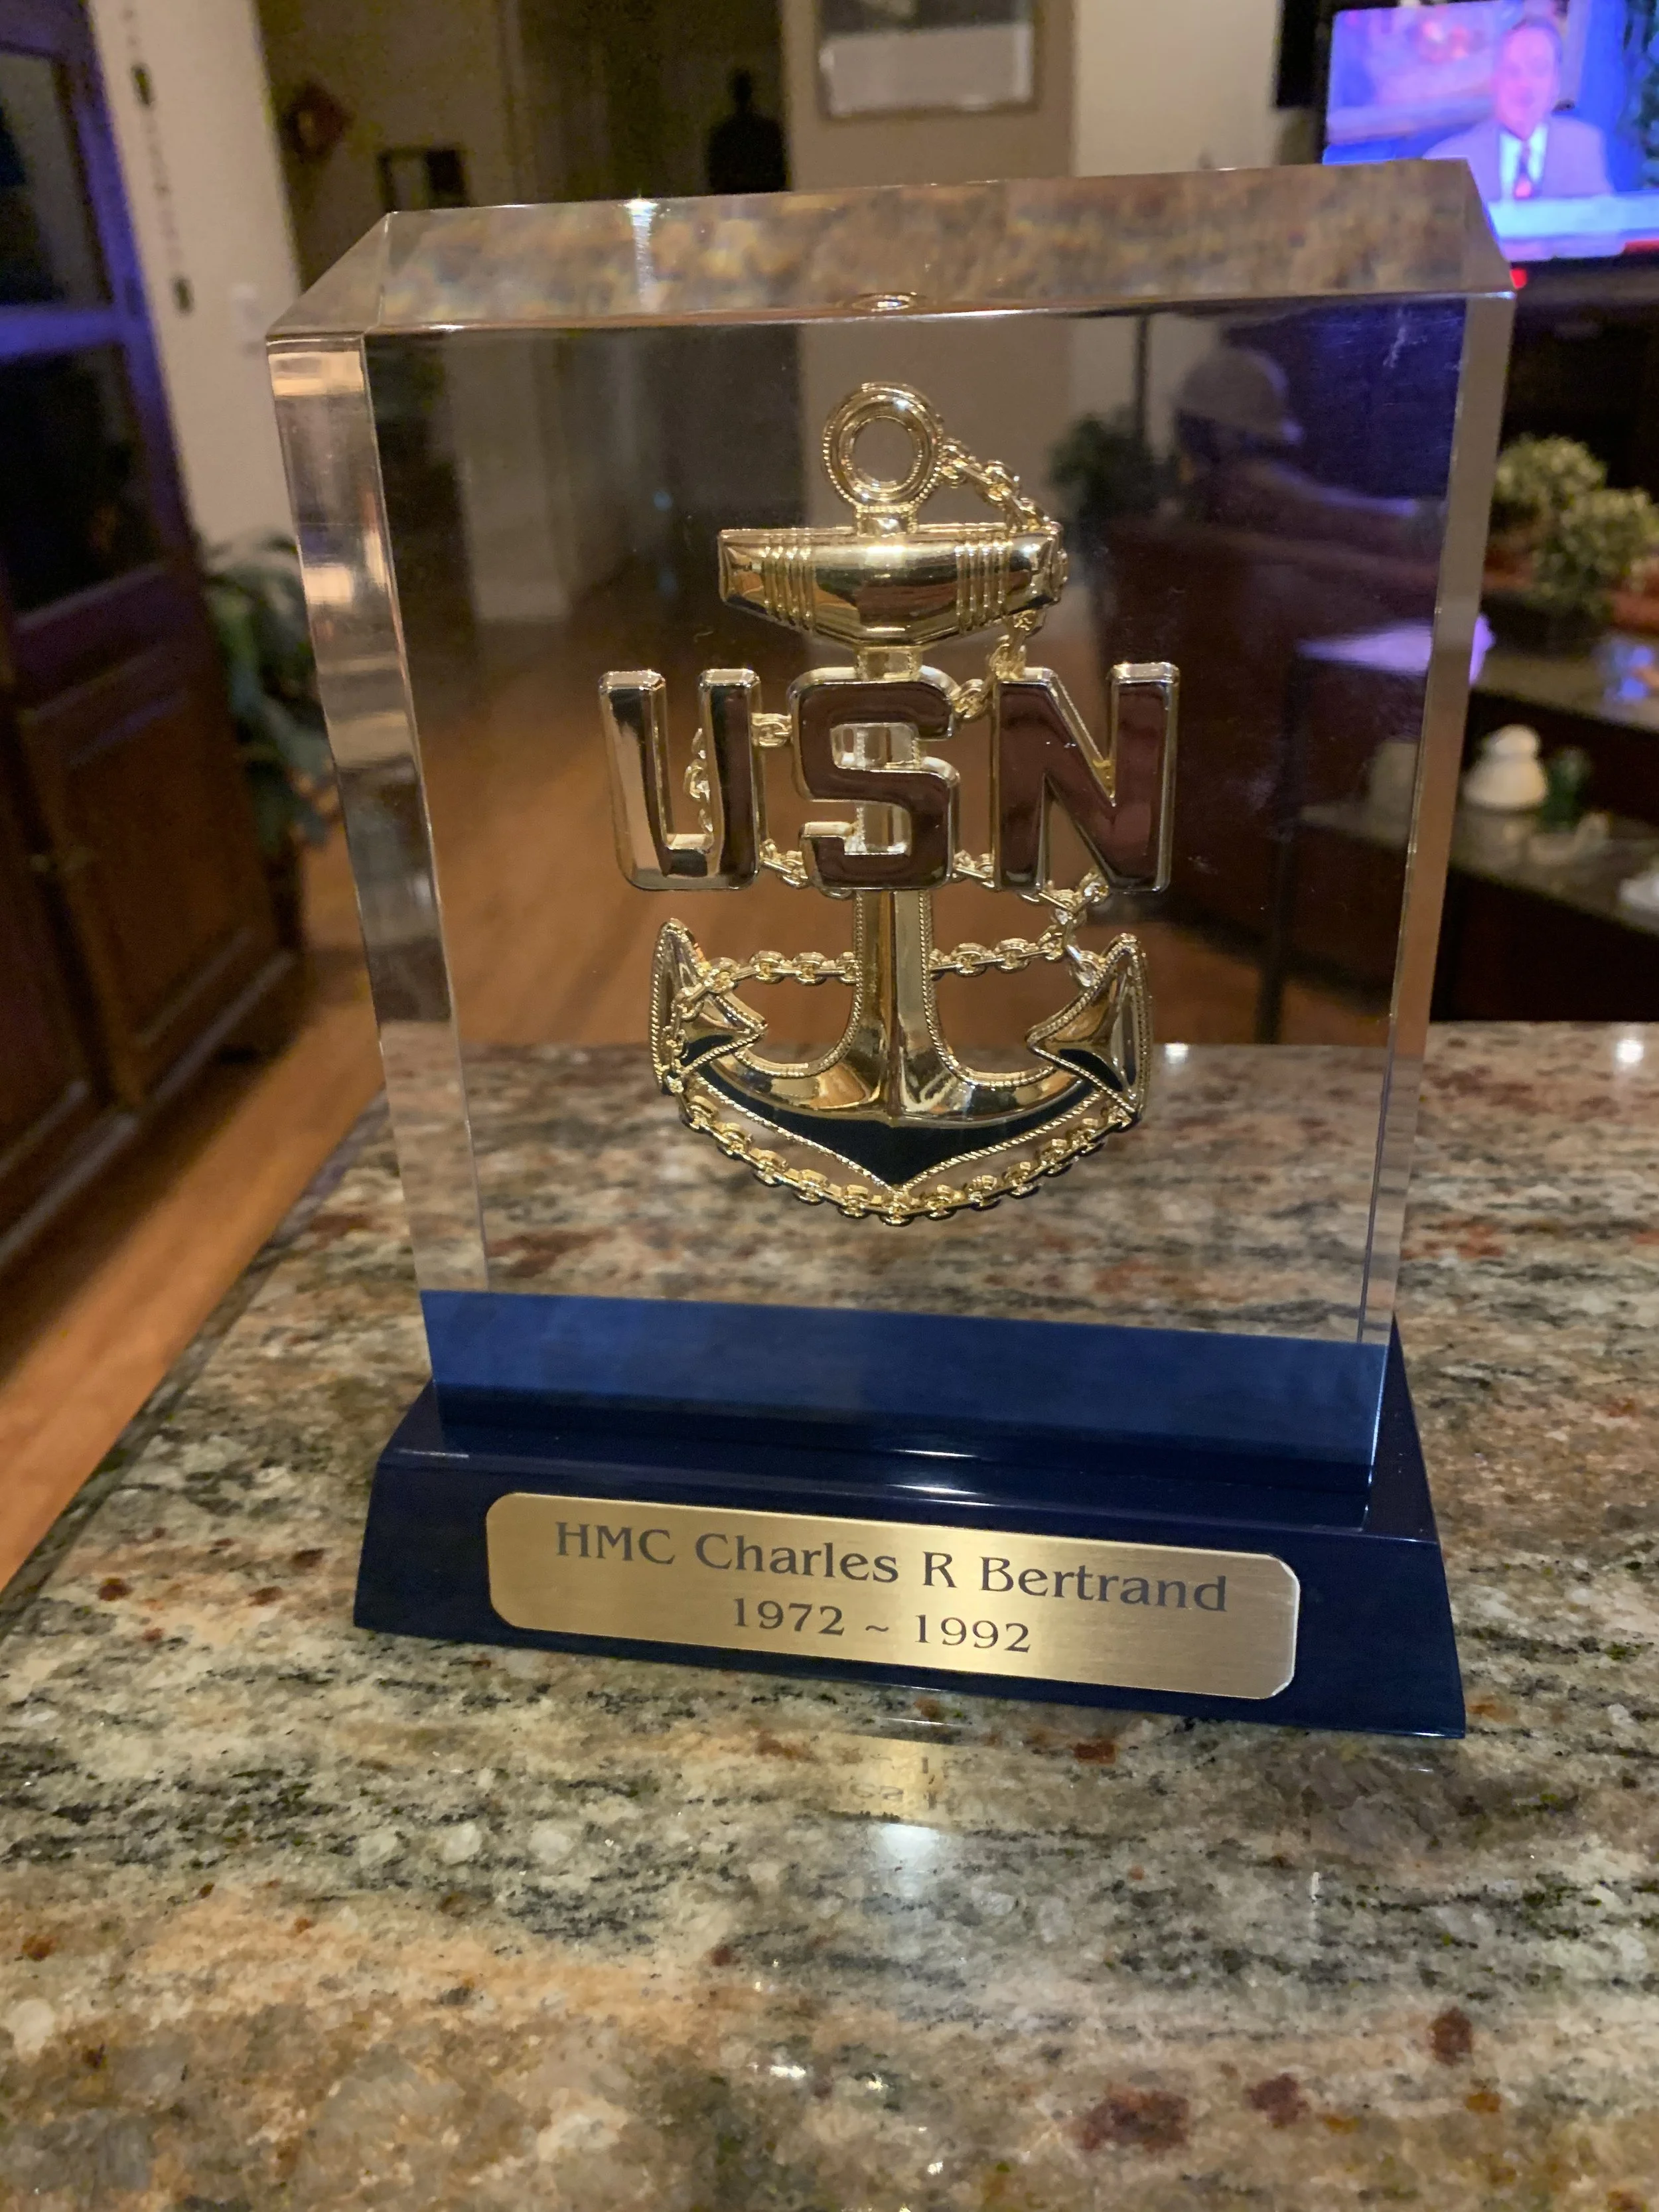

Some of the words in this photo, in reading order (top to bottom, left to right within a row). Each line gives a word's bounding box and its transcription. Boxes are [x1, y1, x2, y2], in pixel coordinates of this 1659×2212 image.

[598, 662, 1180, 894] USN
[556, 1521, 675, 1565] HMC
[695, 1533, 899, 1583] Charles
[922, 1550, 958, 1589] R
[980, 1556, 1228, 1613] Bertrand
[733, 1597, 845, 1636] 1972
[914, 1613, 1031, 1655] 1992
